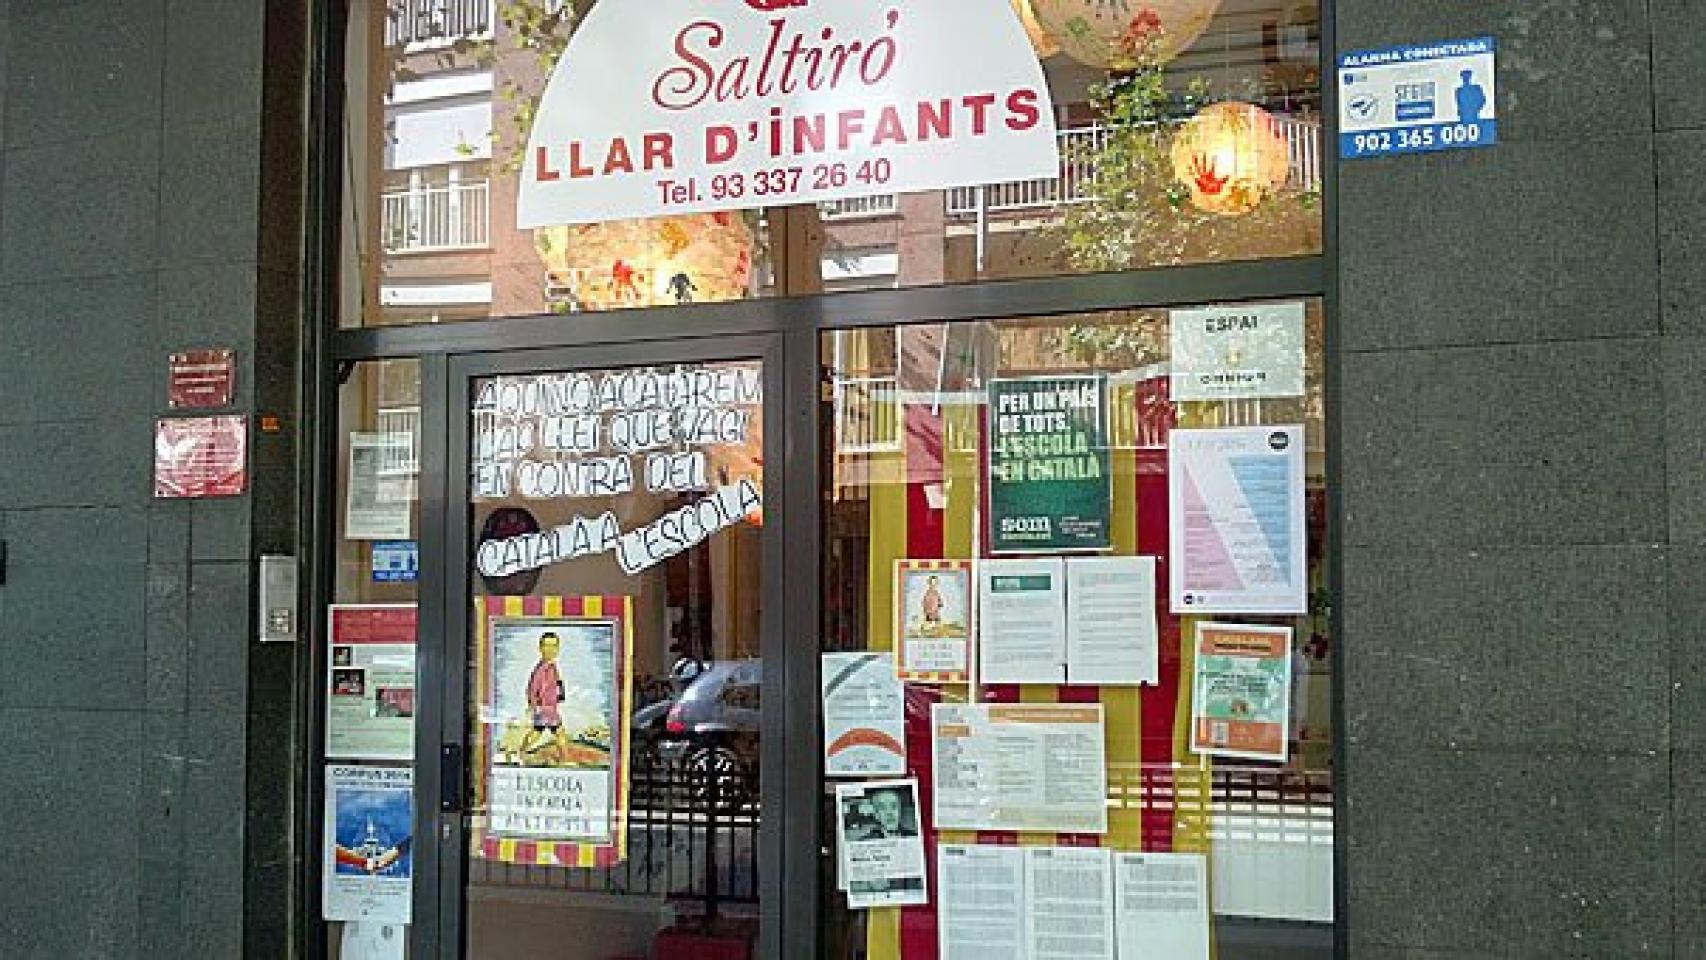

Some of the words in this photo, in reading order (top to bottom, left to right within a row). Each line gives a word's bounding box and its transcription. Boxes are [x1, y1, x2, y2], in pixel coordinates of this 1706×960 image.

[652, 10, 900, 111] Saltiró
[1354, 132, 1392, 152] 902
[1397, 127, 1434, 147] 365
[1440, 123, 1481, 144] 000
[535, 131, 675, 182] LLAR
[656, 178, 703, 207] Tel.
[710, 173, 746, 200] 93
[752, 167, 804, 196] 337
[811, 162, 850, 191] 26
[854, 157, 892, 186] 40
[1000, 393, 1029, 413] PER
[1033, 391, 1055, 410] UN
[610, 411, 674, 447] QUE
[999, 414, 1021, 432] DE
[516, 454, 633, 496] CONTRA
[1001, 460, 1024, 482] EN
